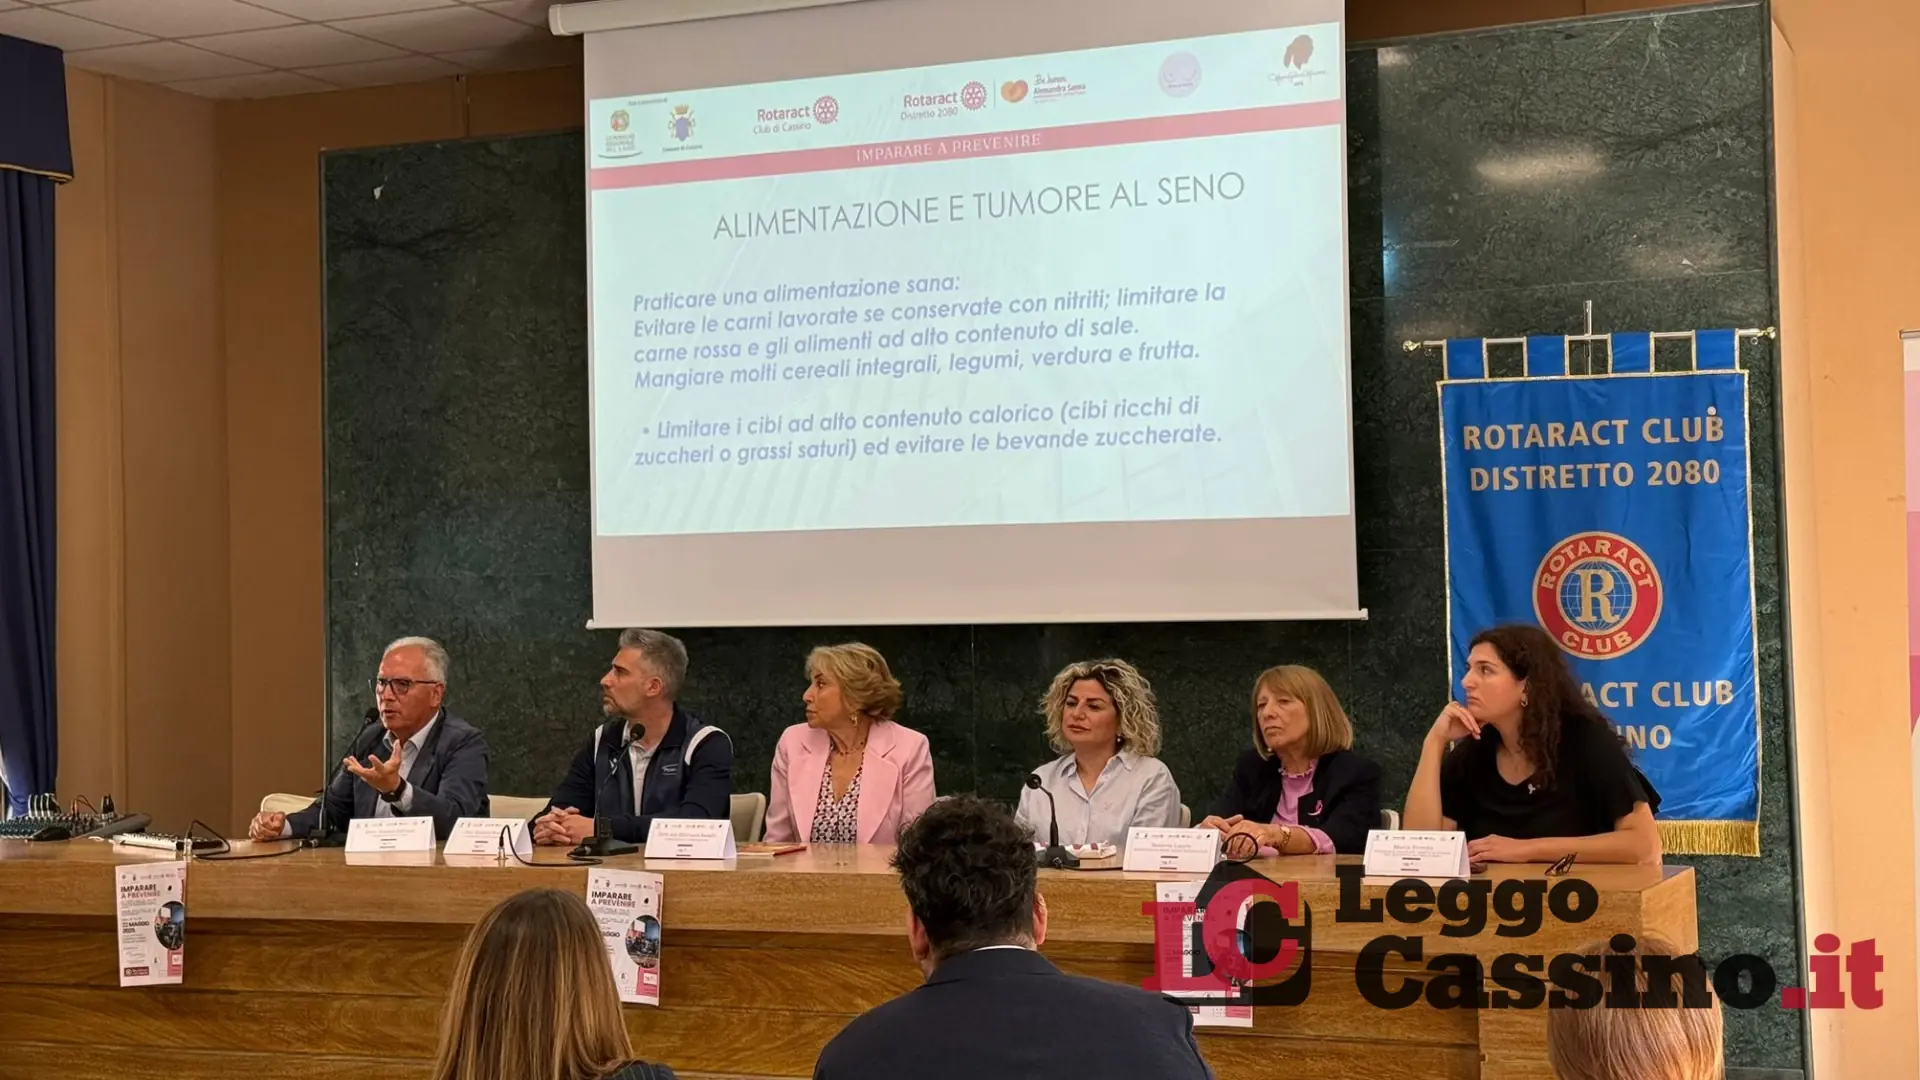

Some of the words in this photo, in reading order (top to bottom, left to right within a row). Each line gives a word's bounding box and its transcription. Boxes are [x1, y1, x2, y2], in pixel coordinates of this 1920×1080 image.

[757, 106, 810, 122] Rotaract
[900, 109, 935, 121] Distretto
[938, 107, 958, 117] 2080
[904, 92, 957, 108] Rotaract
[753, 124, 771, 134] Club
[773, 124, 780, 132] di
[782, 122, 811, 132] Cassino
[857, 143, 932, 162] IMPARARE
[937, 142, 948, 155] A
[952, 133, 1041, 153] PREVENIRE
[713, 197, 939, 239] ALIMENTAZIONE
[949, 195, 964, 221] E
[973, 183, 1101, 219] TUMORE
[1109, 180, 1148, 209] AL
[1157, 172, 1245, 205] SENO
[633, 294, 716, 312] Praticare
[722, 289, 757, 306] una
[763, 278, 900, 303] alimentazione
[906, 275, 960, 293] sana:
[634, 319, 695, 338] Evitare
[702, 316, 718, 333] le
[724, 312, 772, 331] carni
[778, 306, 858, 328] lavorate
[864, 307, 884, 322] se
[891, 298, 1002, 322] conservate
[1009, 298, 1047, 314] con
[1054, 289, 1110, 311] nitriti;
[1117, 285, 1198, 307] limitare
[1205, 282, 1226, 301] la
[634, 345, 687, 363] carne
[694, 343, 741, 359] rossa
[748, 341, 759, 356] e
[766, 337, 788, 359] gli
[794, 332, 871, 354] alimenti
[878, 330, 904, 349] ad
[911, 327, 948, 346] alto
[955, 320, 1058, 344] contenuto
[1065, 318, 1083, 338] di
[1090, 316, 1139, 336] sale.
[634, 367, 724, 390] Mangiare
[730, 364, 777, 384] molti
[782, 359, 851, 381] cereali
[856, 354, 941, 378] integrali,
[949, 349, 1024, 374] legumi,
[1032, 346, 1112, 366] verdura
[1119, 346, 1132, 362] e
[1139, 341, 1200, 361] frutta.
[658, 419, 730, 439] Limitare
[737, 418, 742, 436] i
[748, 415, 782, 436] cibi
[788, 414, 814, 433] ad
[820, 412, 856, 431] alto
[862, 407, 962, 429] contenuto
[969, 403, 1053, 425] calorico
[1060, 399, 1107, 425] (cibi
[1114, 397, 1172, 418] ricchi
[1179, 396, 1199, 415] di
[634, 443, 714, 466] zuccheri
[720, 447, 731, 462] o
[738, 441, 792, 465] grassi
[798, 438, 856, 459] saturi)
[863, 437, 889, 456] ed
[895, 433, 964, 454] evitare
[971, 431, 989, 451] le
[996, 429, 1088, 451] bevande
[1096, 424, 1222, 447] zuccherate.
[1463, 419, 1629, 451] ROTARACT
[1642, 416, 1724, 443] CLUB
[1471, 462, 1634, 492] DISTRETTO
[1647, 460, 1720, 486] 2080
[1540, 539, 1654, 590] ROTARACT
[1576, 569, 1620, 623] R
[1561, 630, 1633, 653] CLUB
[1651, 680, 1734, 707] CLUB
[121, 884, 156, 892] IMPARARE
[128, 890, 160, 898] PREVENIRE
[592, 891, 632, 900] IMPARARE
[598, 899, 636, 908] PREVENIRE
